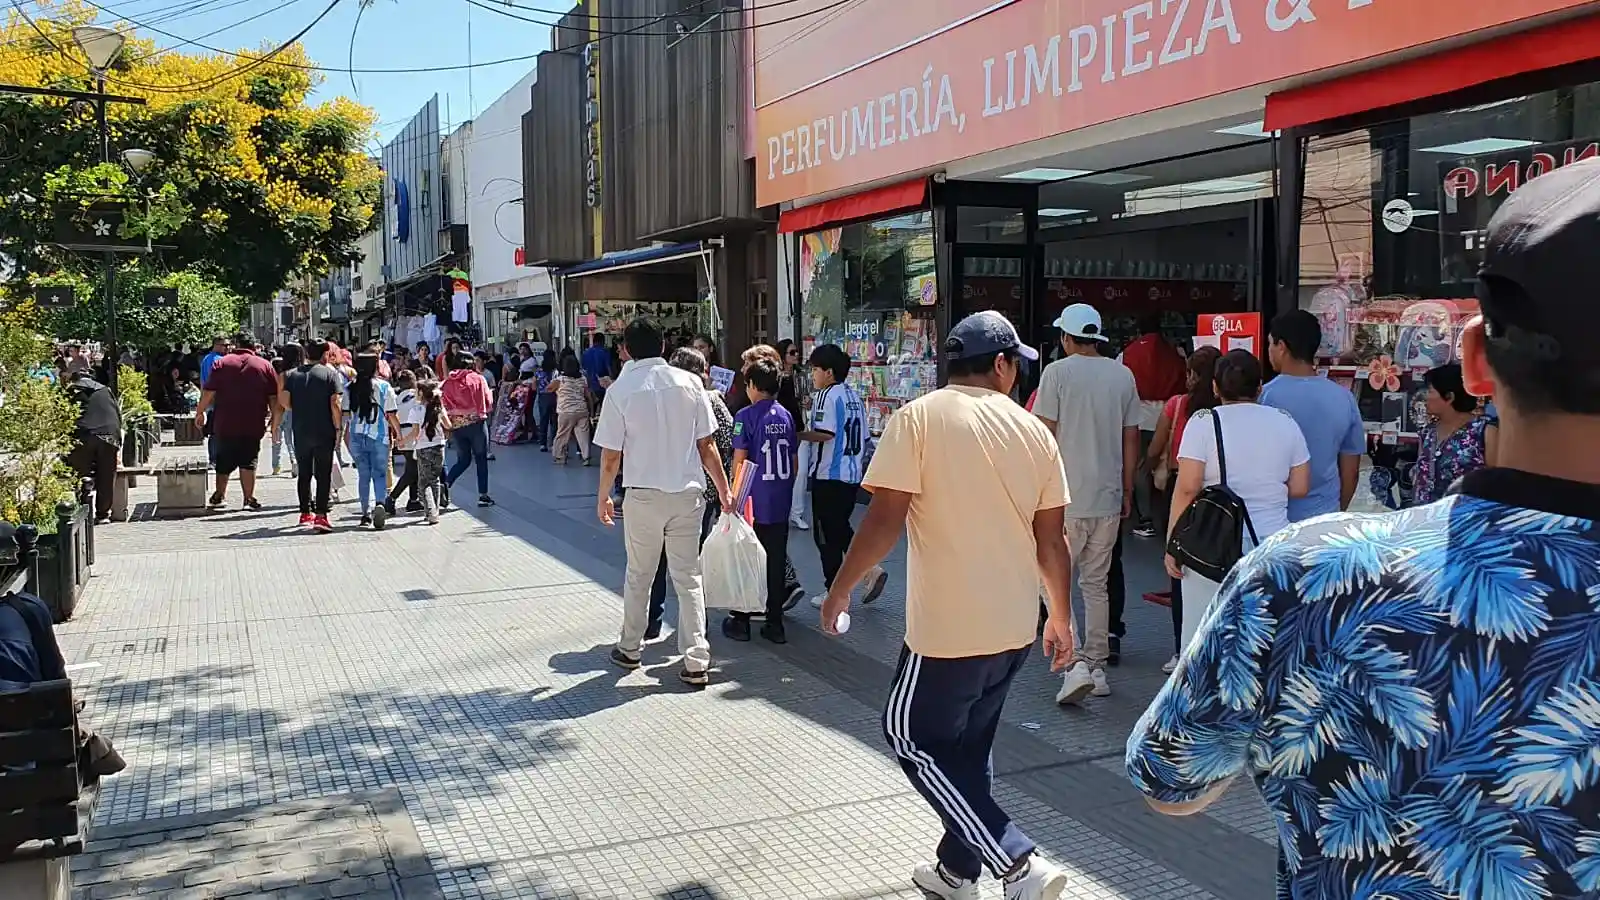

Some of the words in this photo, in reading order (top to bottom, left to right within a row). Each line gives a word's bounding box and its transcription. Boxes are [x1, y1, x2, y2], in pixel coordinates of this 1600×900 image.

[766, 62, 967, 181] PERFUMERÍA,
[981, 0, 1242, 118] LIMPIEZA
[844, 318, 869, 340] Llegó
[870, 319, 879, 335] el
[1212, 318, 1243, 332] BELLA
[764, 423, 787, 435] MESSI
[843, 416, 862, 457] 10
[760, 438, 791, 481] 10
